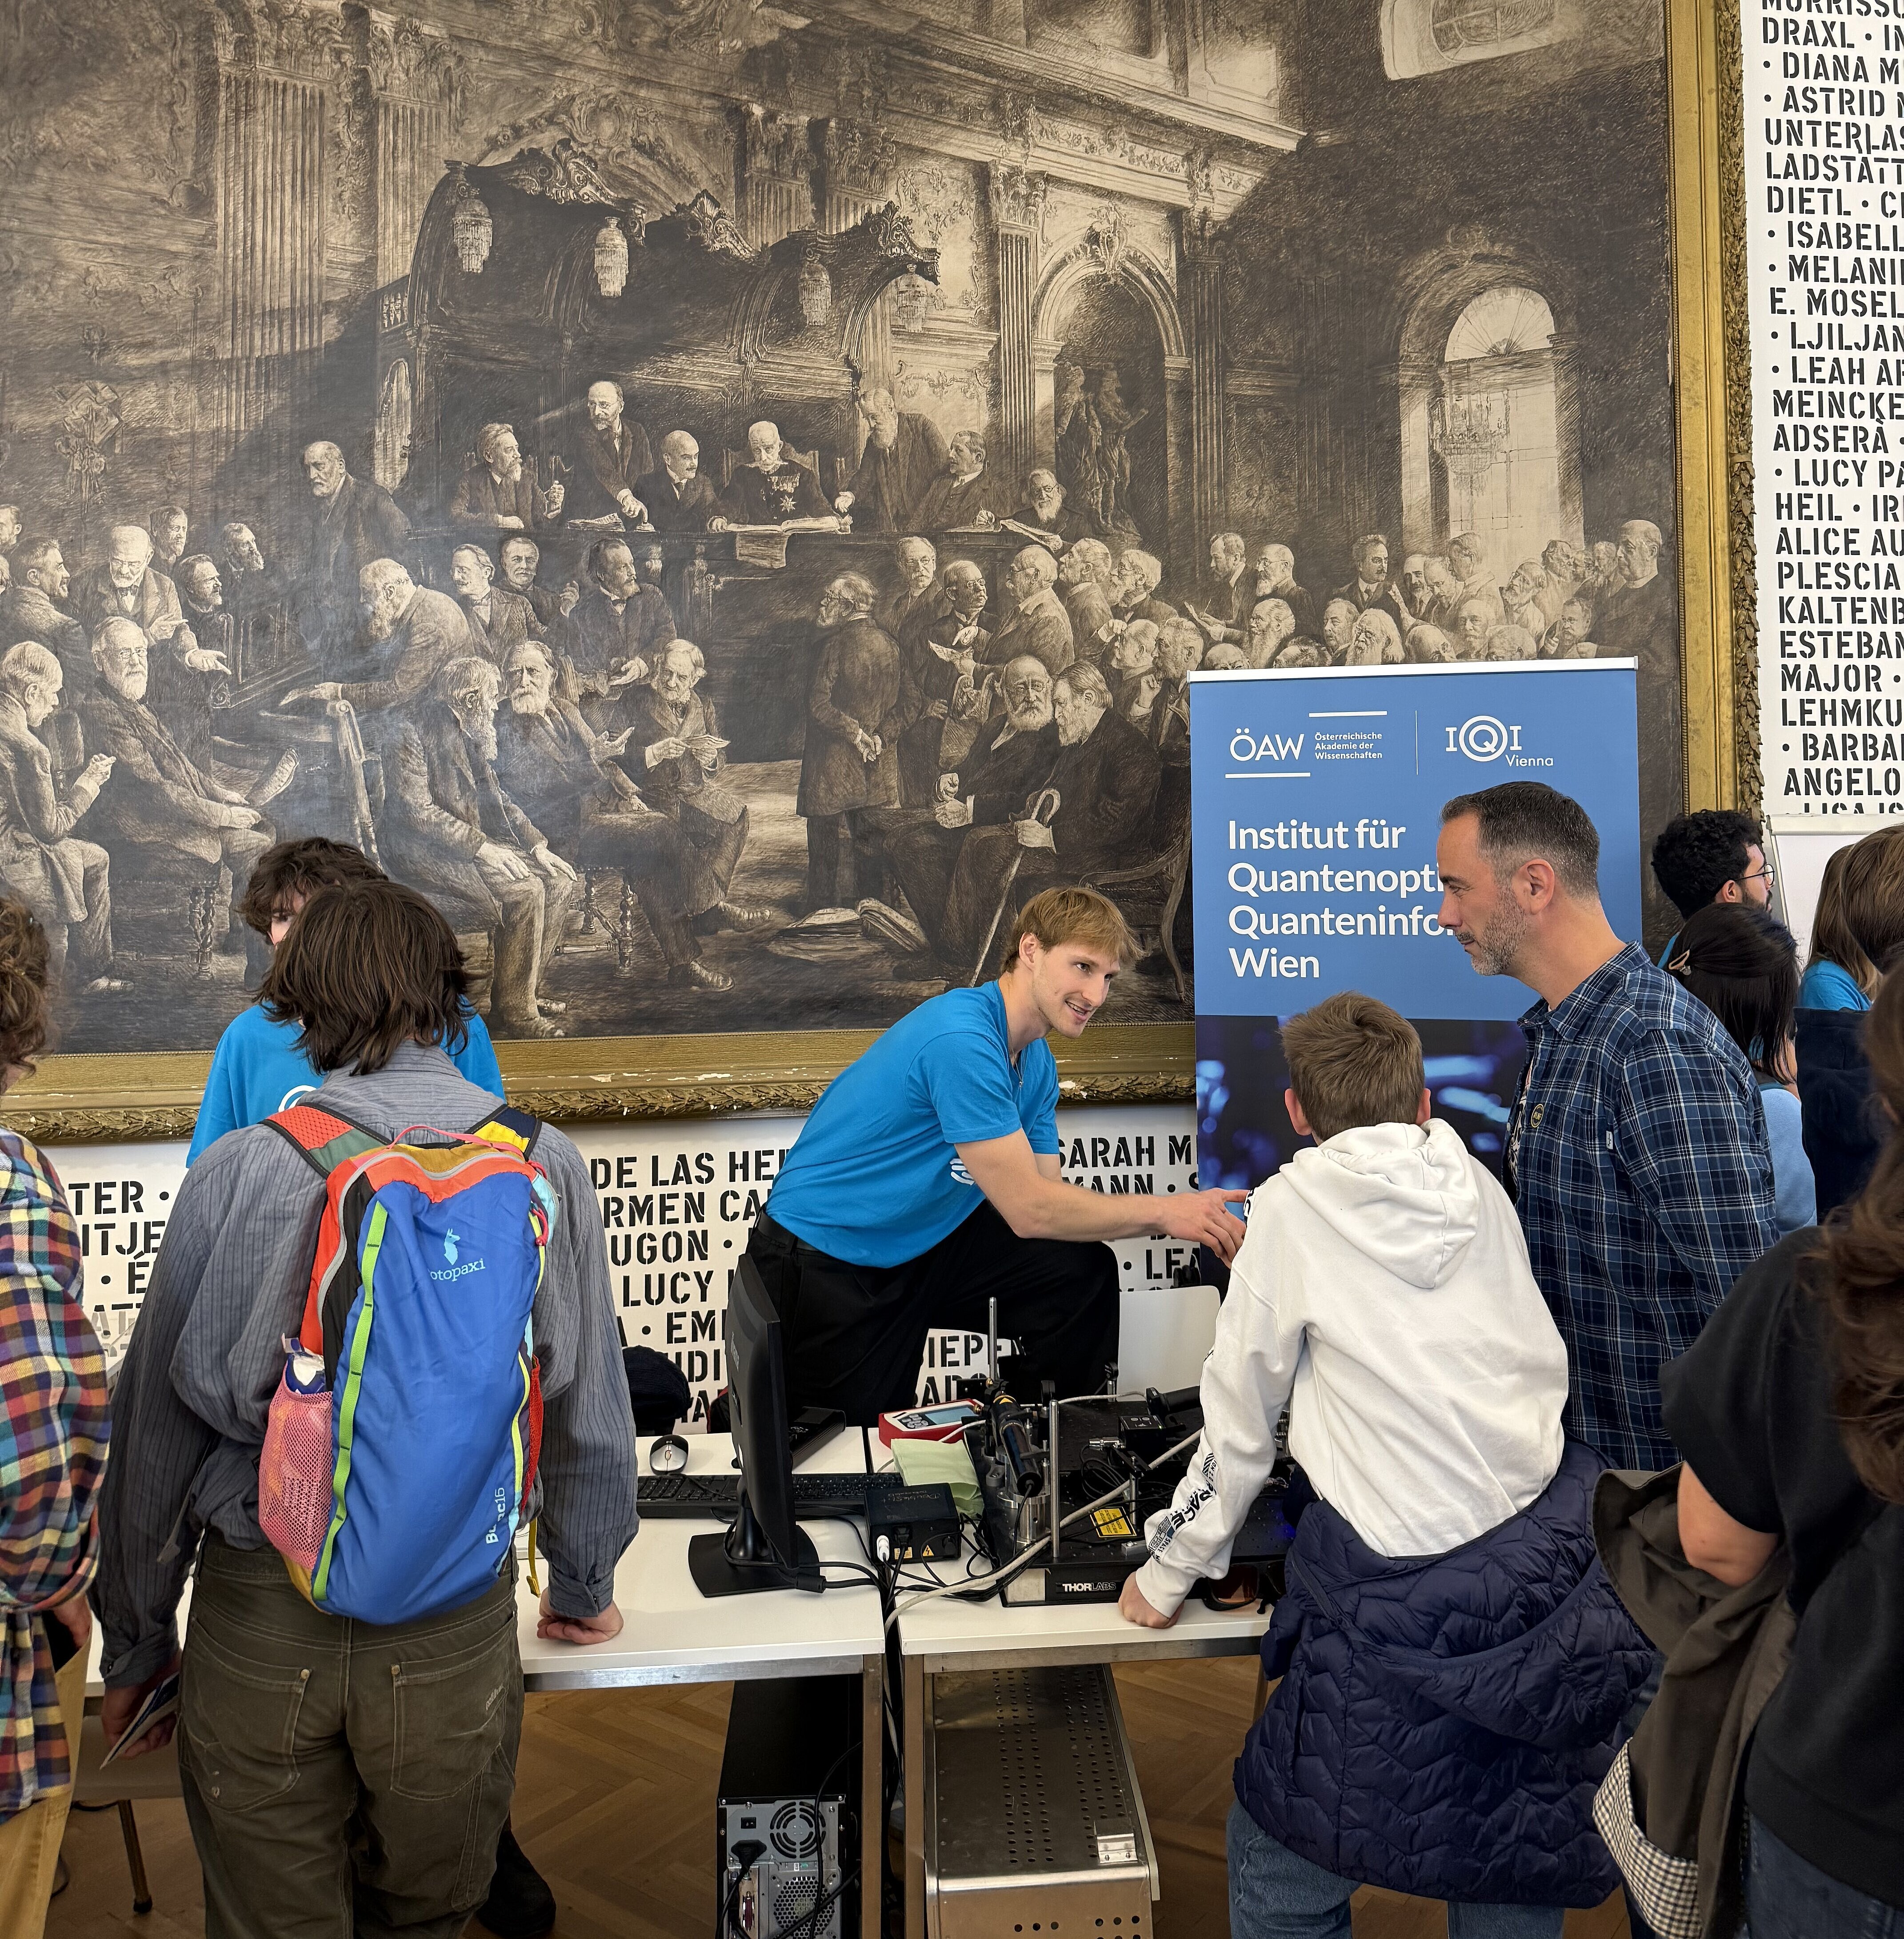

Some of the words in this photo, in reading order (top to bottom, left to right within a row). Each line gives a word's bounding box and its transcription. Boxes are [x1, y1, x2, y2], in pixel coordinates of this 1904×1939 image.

[1763, 17, 1854, 48] DRAXL
[1784, 52, 1869, 82] DIANA
[1880, 58, 1904, 84] M
[1783, 86, 1884, 116] ASTRID
[1766, 119, 1904, 154] UNTERLA
[1768, 186, 1851, 216] DIETL
[1789, 255, 1904, 285] MELANI
[1770, 288, 1795, 314] E.
[1807, 289, 1904, 318] MOSEL
[1791, 322, 1904, 352] LJILJAN
[1792, 356, 1864, 384] LEAH
[1773, 390, 1904, 420] MEINCKE
[1773, 418, 1888, 453] ADSERÀ
[1795, 459, 1867, 487] LUCY
[1776, 493, 1842, 520] HEIL
[1873, 495, 1904, 522] IR
[1776, 528, 1860, 555] ALICE
[1778, 562, 1900, 590] PLESCIA
[1779, 596, 1904, 624] KALTENB
[1780, 631, 1904, 658] ESTEBAN
[1781, 664, 1882, 692] MAJOR
[1782, 699, 1902, 726] LEHMKU
[1230, 728, 1304, 761] ÖAW
[1315, 732, 1382, 740] Österreichische
[1446, 716, 1521, 764] IQI
[1505, 755, 1553, 766] Vienna
[1784, 768, 1900, 796] ANGELO
[1230, 820, 1349, 849] Institut
[1355, 819, 1406, 848] für
[1229, 905, 1453, 940] Quanteninfo
[1229, 948, 1319, 977] Wien
[1168, 1135, 1198, 1165] M
[591, 1156, 637, 1190] DE
[652, 1152, 715, 1187] LAS
[68, 1180, 144, 1216] TER
[604, 1192, 704, 1228] RMEN
[720, 1188, 772, 1222] CA
[611, 1230, 708, 1266] UGON
[428, 1258, 486, 1282] otopaxi
[623, 1270, 714, 1307] LUCY
[1062, 1582, 1116, 1592] THORLABS
